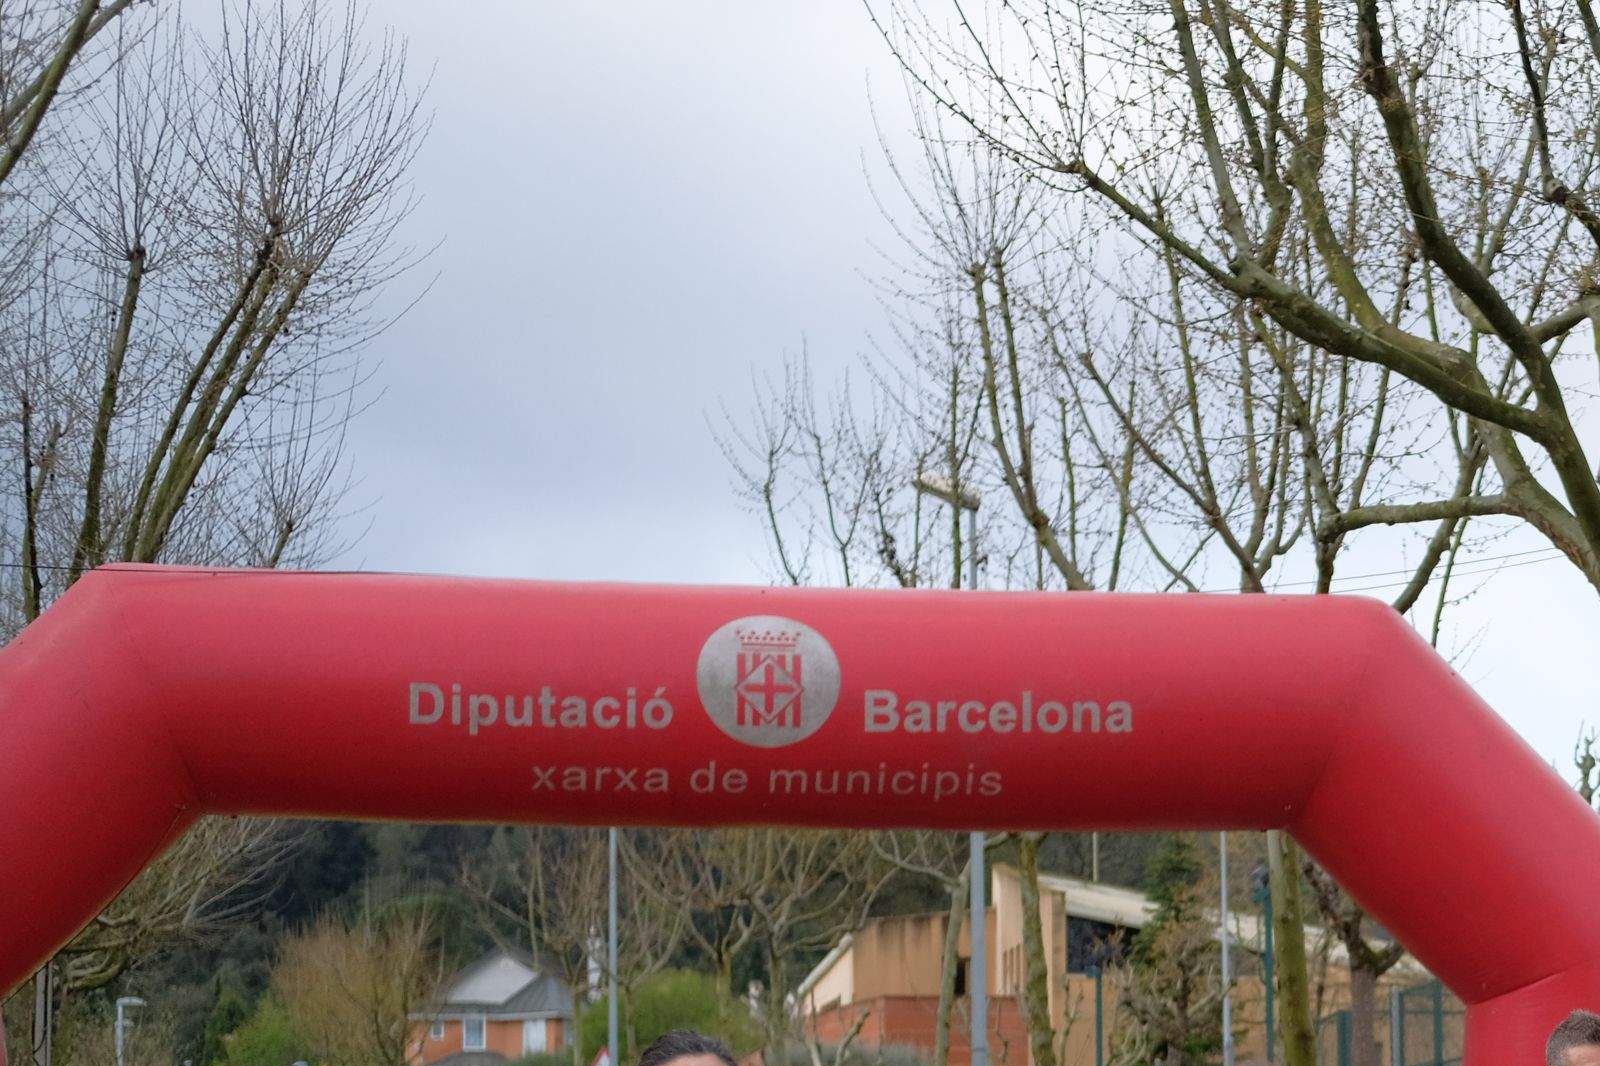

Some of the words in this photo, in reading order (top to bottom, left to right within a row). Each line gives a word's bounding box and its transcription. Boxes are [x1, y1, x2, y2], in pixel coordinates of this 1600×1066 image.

[408, 682, 674, 735] Diputació
[863, 690, 1134, 734] Barcelona
[531, 765, 670, 793] xarxa
[689, 760, 748, 794] de
[769, 762, 1002, 801] municipis
